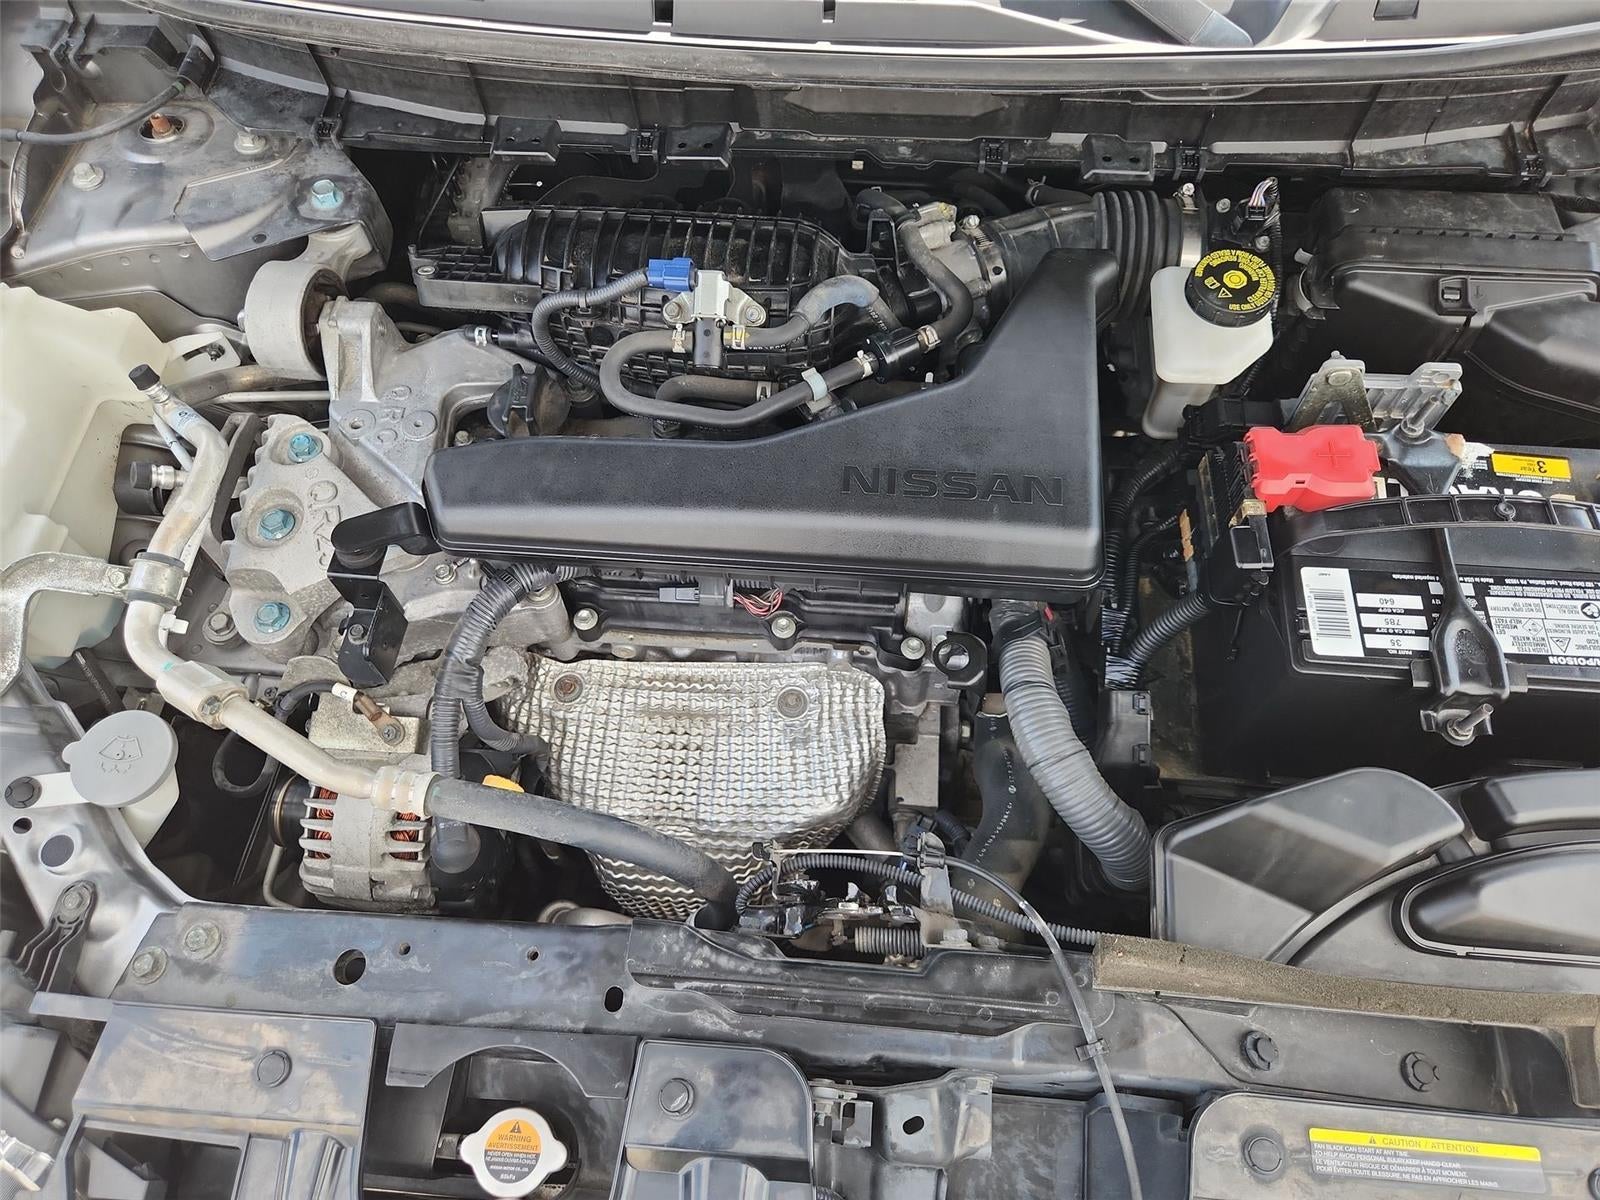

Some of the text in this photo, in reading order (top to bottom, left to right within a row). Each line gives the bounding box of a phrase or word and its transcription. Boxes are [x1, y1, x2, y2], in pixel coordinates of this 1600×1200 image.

[1536, 461, 1547, 473] 3
[841, 465, 1064, 506] NISSAN
[1384, 618, 1400, 626] 785
[1390, 639, 1402, 647] 35
[498, 1134, 532, 1143] WARNING
[488, 1142, 538, 1150] AVERTISSEMENT
[1382, 1137, 1421, 1148] CAUTION
[1431, 1142, 1479, 1153] ATTENTION
[1357, 1146, 1375, 1154] START
[1356, 1154, 1387, 1162] PERSONAL
[1323, 1159, 1359, 1167] VENTILATEUR
[1360, 1162, 1380, 1170] RISQUE
[1427, 1168, 1442, 1176] TOUT
[1333, 1165, 1352, 1174] ÉVITER
[1432, 1176, 1468, 1185] APPROCHER
